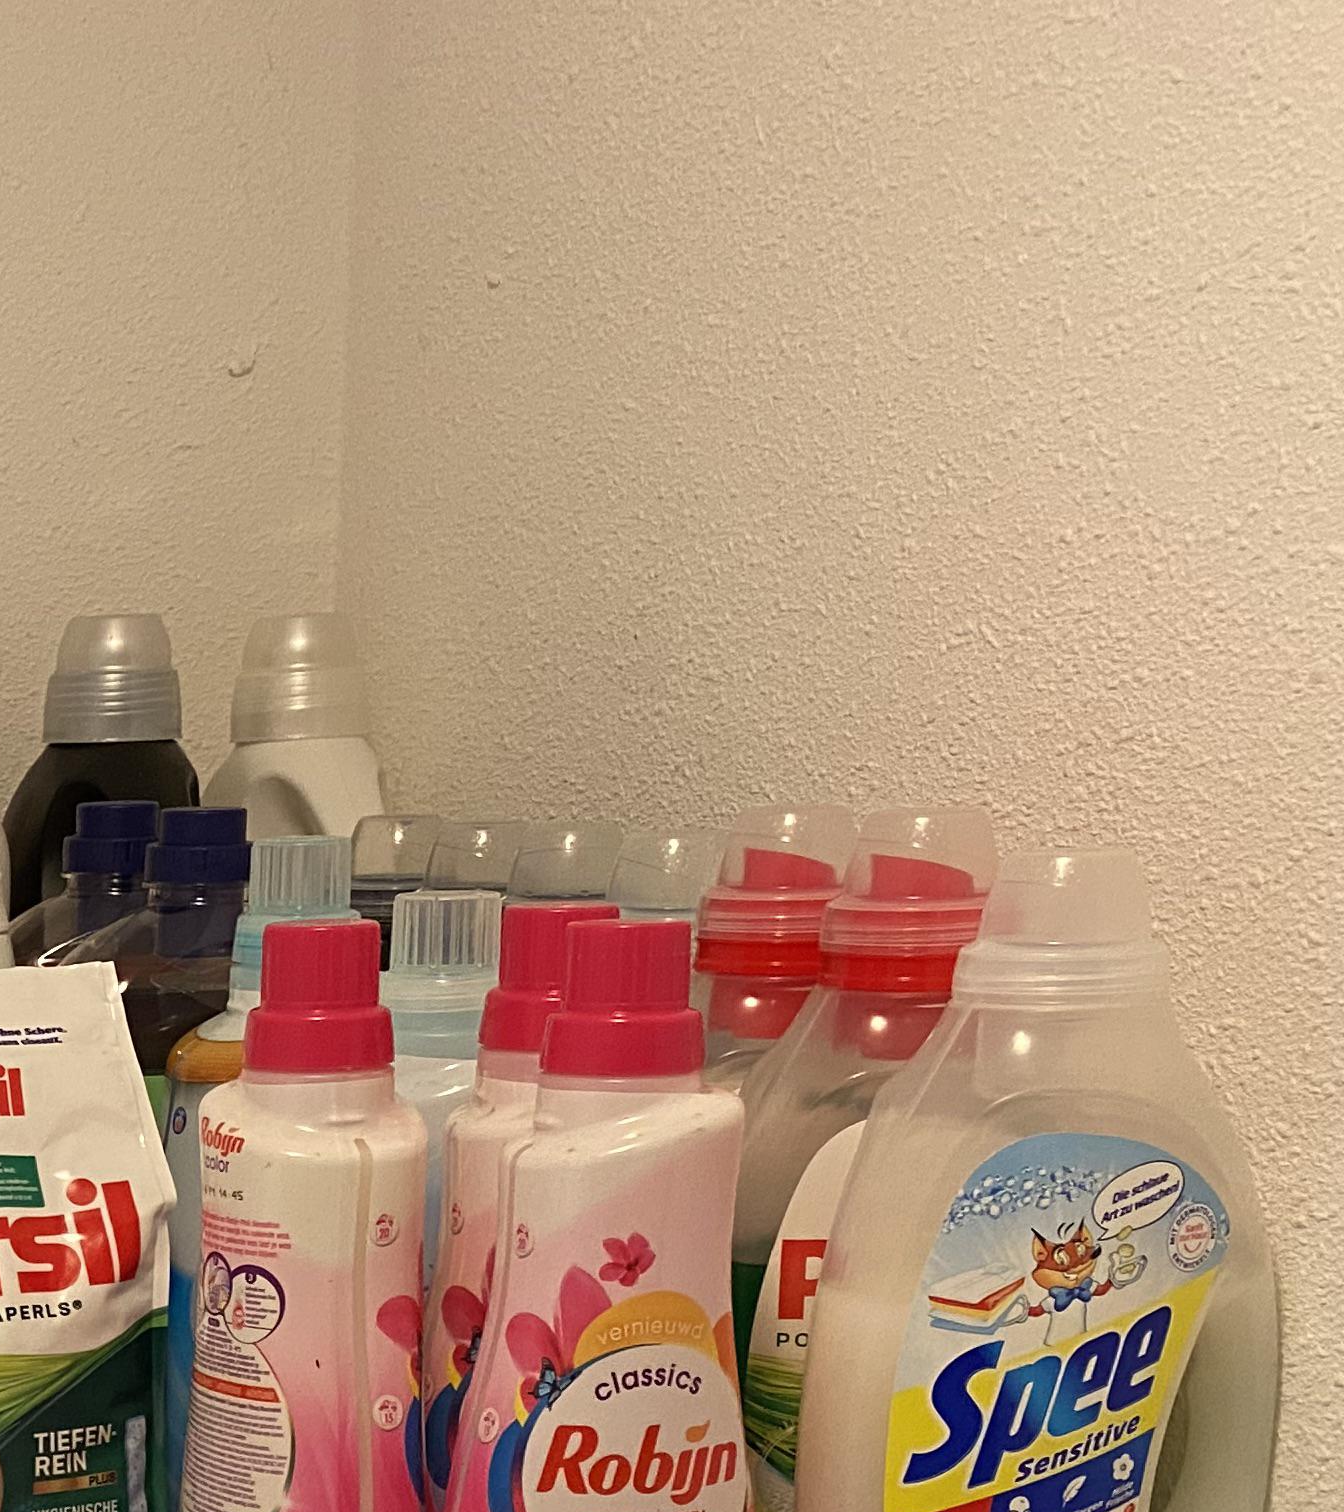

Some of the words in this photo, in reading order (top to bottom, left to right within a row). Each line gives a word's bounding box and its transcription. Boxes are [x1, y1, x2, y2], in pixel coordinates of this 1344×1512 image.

[201, 1116, 245, 1158] Robijn
[595, 1318, 704, 1346] vernieuwd
[593, 1362, 702, 1402] classics
[902, 1304, 1172, 1490] Spee
[33, 1424, 117, 1455] TIEFEN-
[34, 1451, 87, 1478] REIN
[535, 1419, 738, 1505] Robijn
